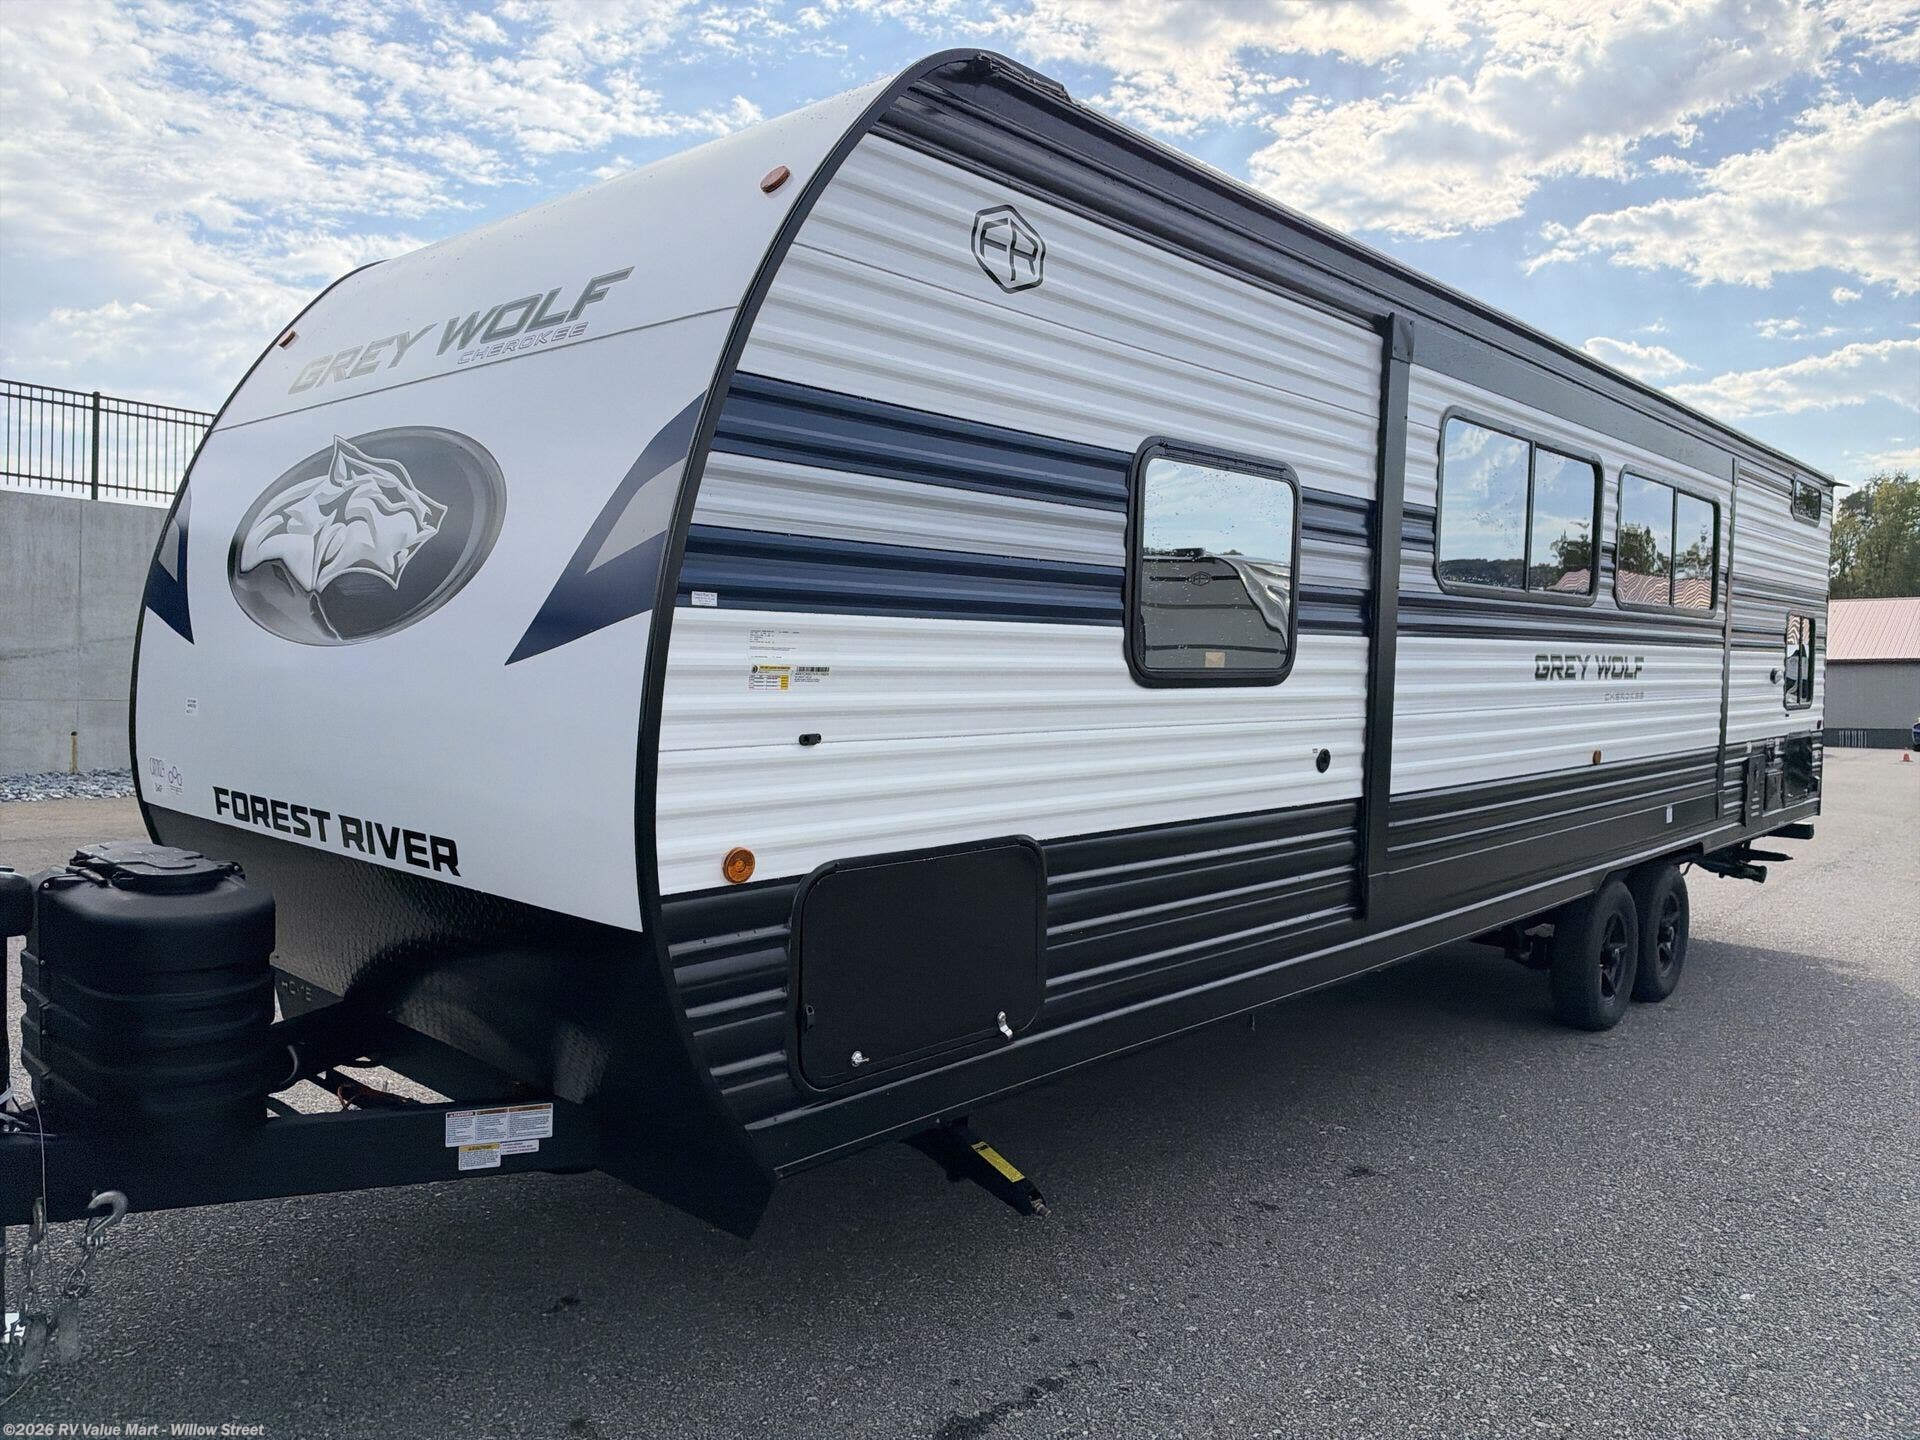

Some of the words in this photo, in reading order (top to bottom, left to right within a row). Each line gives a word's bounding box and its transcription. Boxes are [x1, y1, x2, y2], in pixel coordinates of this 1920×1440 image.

[288, 323, 438, 395] GREY
[436, 266, 635, 356] WOLF
[456, 321, 590, 365] CHEROKEE
[1534, 654, 1591, 681] GREY
[1595, 654, 1645, 680] WOLF
[212, 786, 331, 842] FOREST
[338, 814, 461, 877] RIVER
